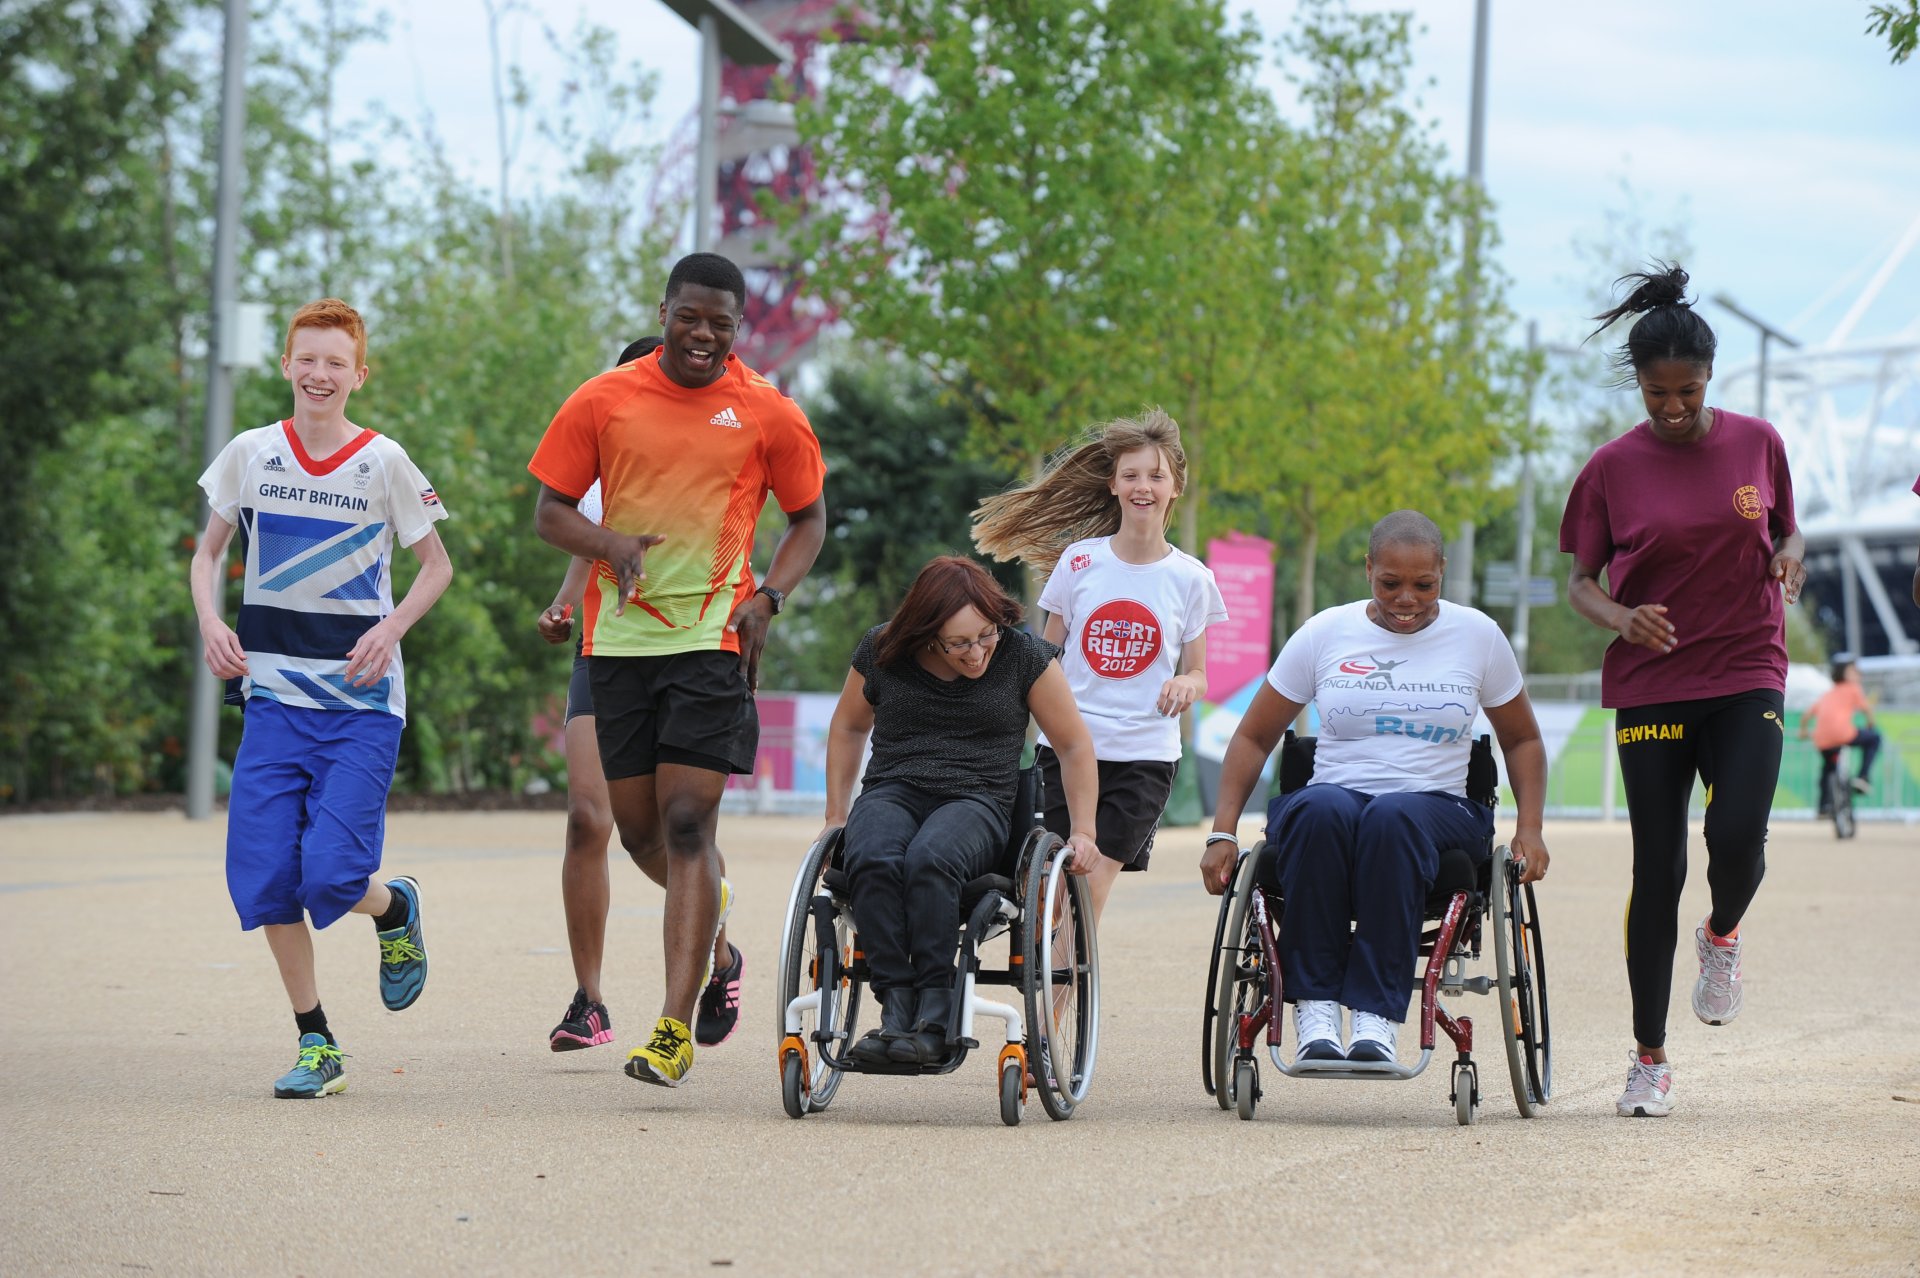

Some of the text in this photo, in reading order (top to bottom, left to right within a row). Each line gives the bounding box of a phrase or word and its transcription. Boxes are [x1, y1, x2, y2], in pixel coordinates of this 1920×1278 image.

[710, 418, 742, 429] adidas
[263, 464, 286, 473] adidas
[259, 483, 369, 511] GREAT BRITAIN
[1089, 619, 1156, 642] SPORT
[1087, 637, 1155, 658] RELIEF
[1100, 657, 1136, 672] 2012
[1323, 679, 1473, 696] ENGLAND ATHLETICS
[1375, 715, 1468, 745] Run!
[1616, 724, 1684, 746] NEWHAM
